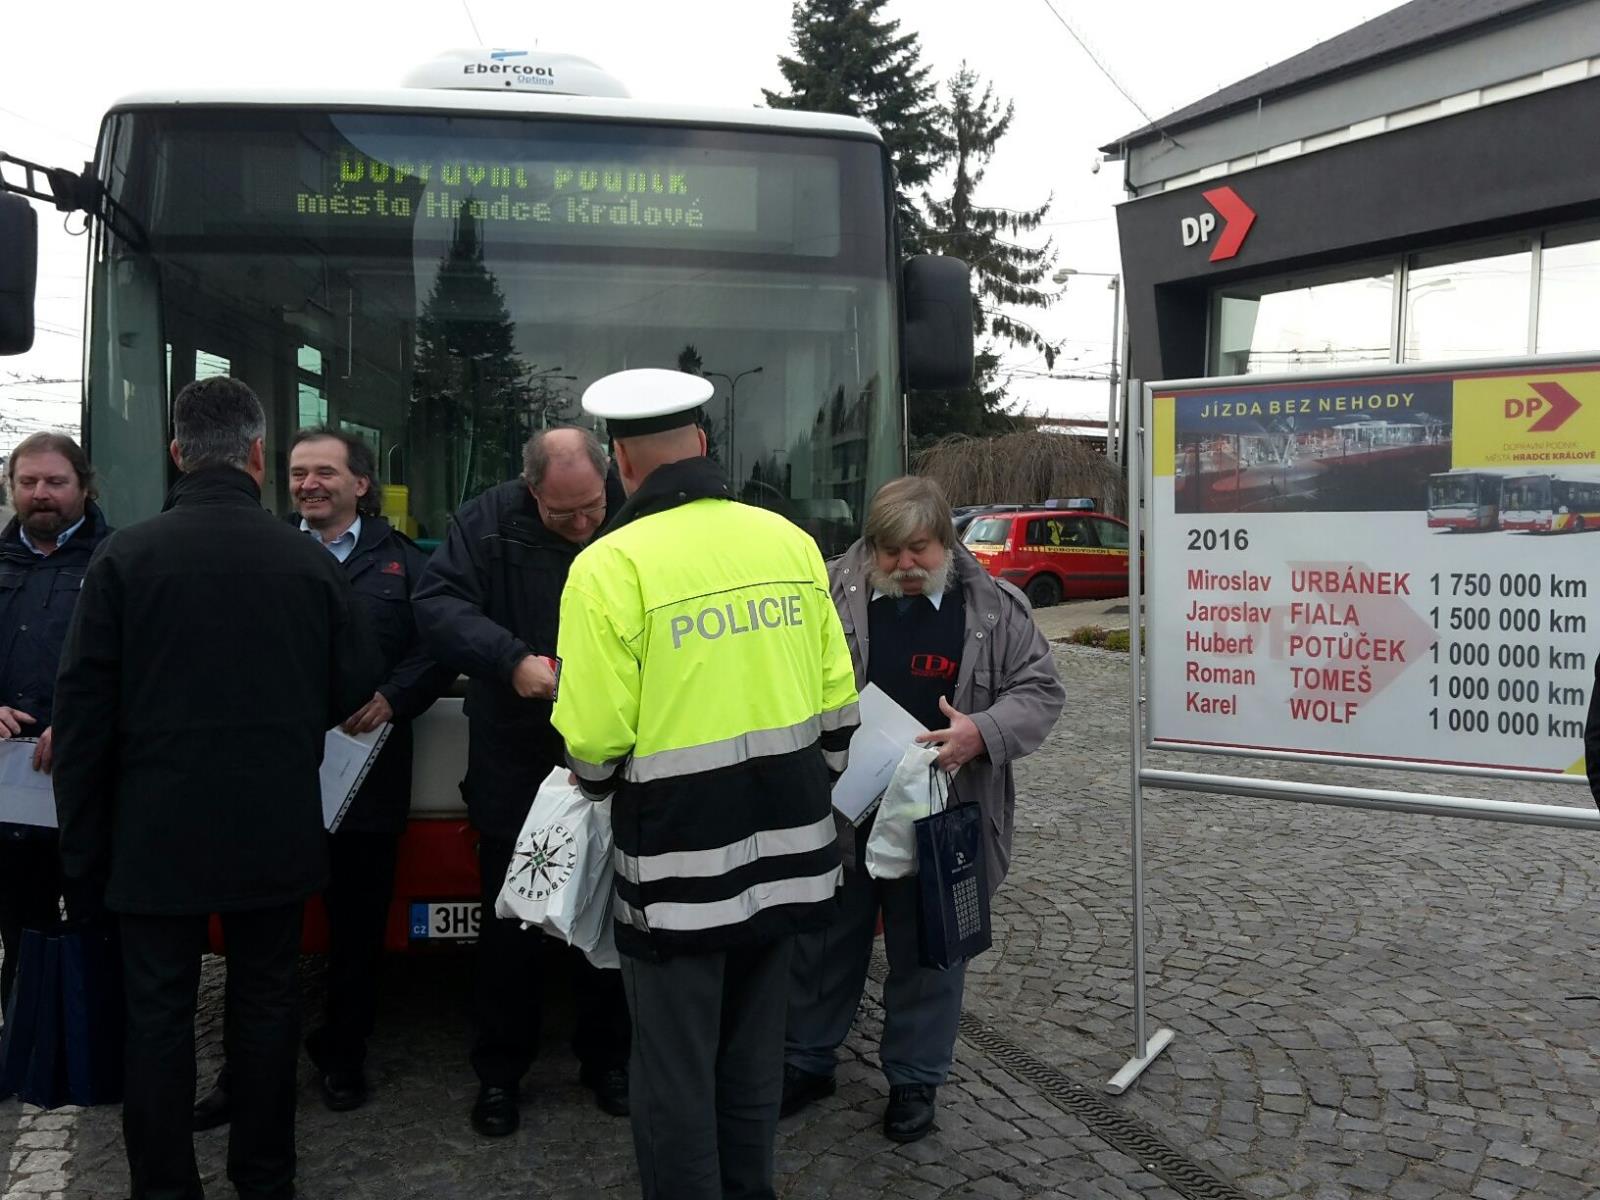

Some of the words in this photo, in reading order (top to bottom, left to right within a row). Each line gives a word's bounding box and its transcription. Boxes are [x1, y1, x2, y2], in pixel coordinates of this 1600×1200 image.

[463, 63, 554, 77] Ebercool
[517, 75, 554, 85] Optima
[297, 182, 411, 216] města
[426, 191, 552, 222] Hradce
[568, 194, 703, 227] Králové
[1181, 213, 1215, 246] DP
[1201, 400, 1262, 418] JÍZDA
[1269, 399, 1311, 415] BEZ
[1319, 393, 1415, 411] NEHODY
[1505, 398, 1543, 418] DP
[1513, 452, 1551, 461] HRADCE
[1552, 450, 1597, 460] KRÁLOVÉ
[1187, 529, 1249, 550] 2016
[1187, 569, 1271, 591] Miroslav
[1291, 566, 1410, 595] URBÁNEK
[1430, 573, 1440, 595] 1
[1450, 573, 1491, 596] 750
[1500, 573, 1541, 597] 000
[1550, 574, 1587, 598] km
[671, 595, 803, 649] POLICIE
[1186, 600, 1271, 623] Jaroslav
[1290, 602, 1360, 626] FIALA
[1430, 606, 1439, 629] 1
[1450, 607, 1490, 630] 500
[1499, 608, 1541, 632] 000
[1550, 609, 1586, 633] km
[1187, 631, 1253, 654] Hubert
[1290, 632, 1406, 662] POTŮČEK
[1429, 641, 1439, 664] 1
[1449, 642, 1489, 666] 000
[1499, 644, 1540, 668] 000
[1549, 646, 1585, 670] km
[1187, 661, 1255, 685] Roman
[1290, 665, 1372, 693] TOMEŠ
[1429, 675, 1438, 697] 1
[1449, 676, 1489, 700] 000
[1498, 679, 1539, 703] 000
[1548, 681, 1584, 706] km
[1186, 691, 1236, 715] Karel
[1290, 698, 1358, 724] WOLF
[1429, 707, 1438, 730] 1
[1449, 709, 1489, 733] 000
[1498, 711, 1539, 736] 000
[1548, 714, 1584, 738] km
[413, 925, 427, 935] CZ
